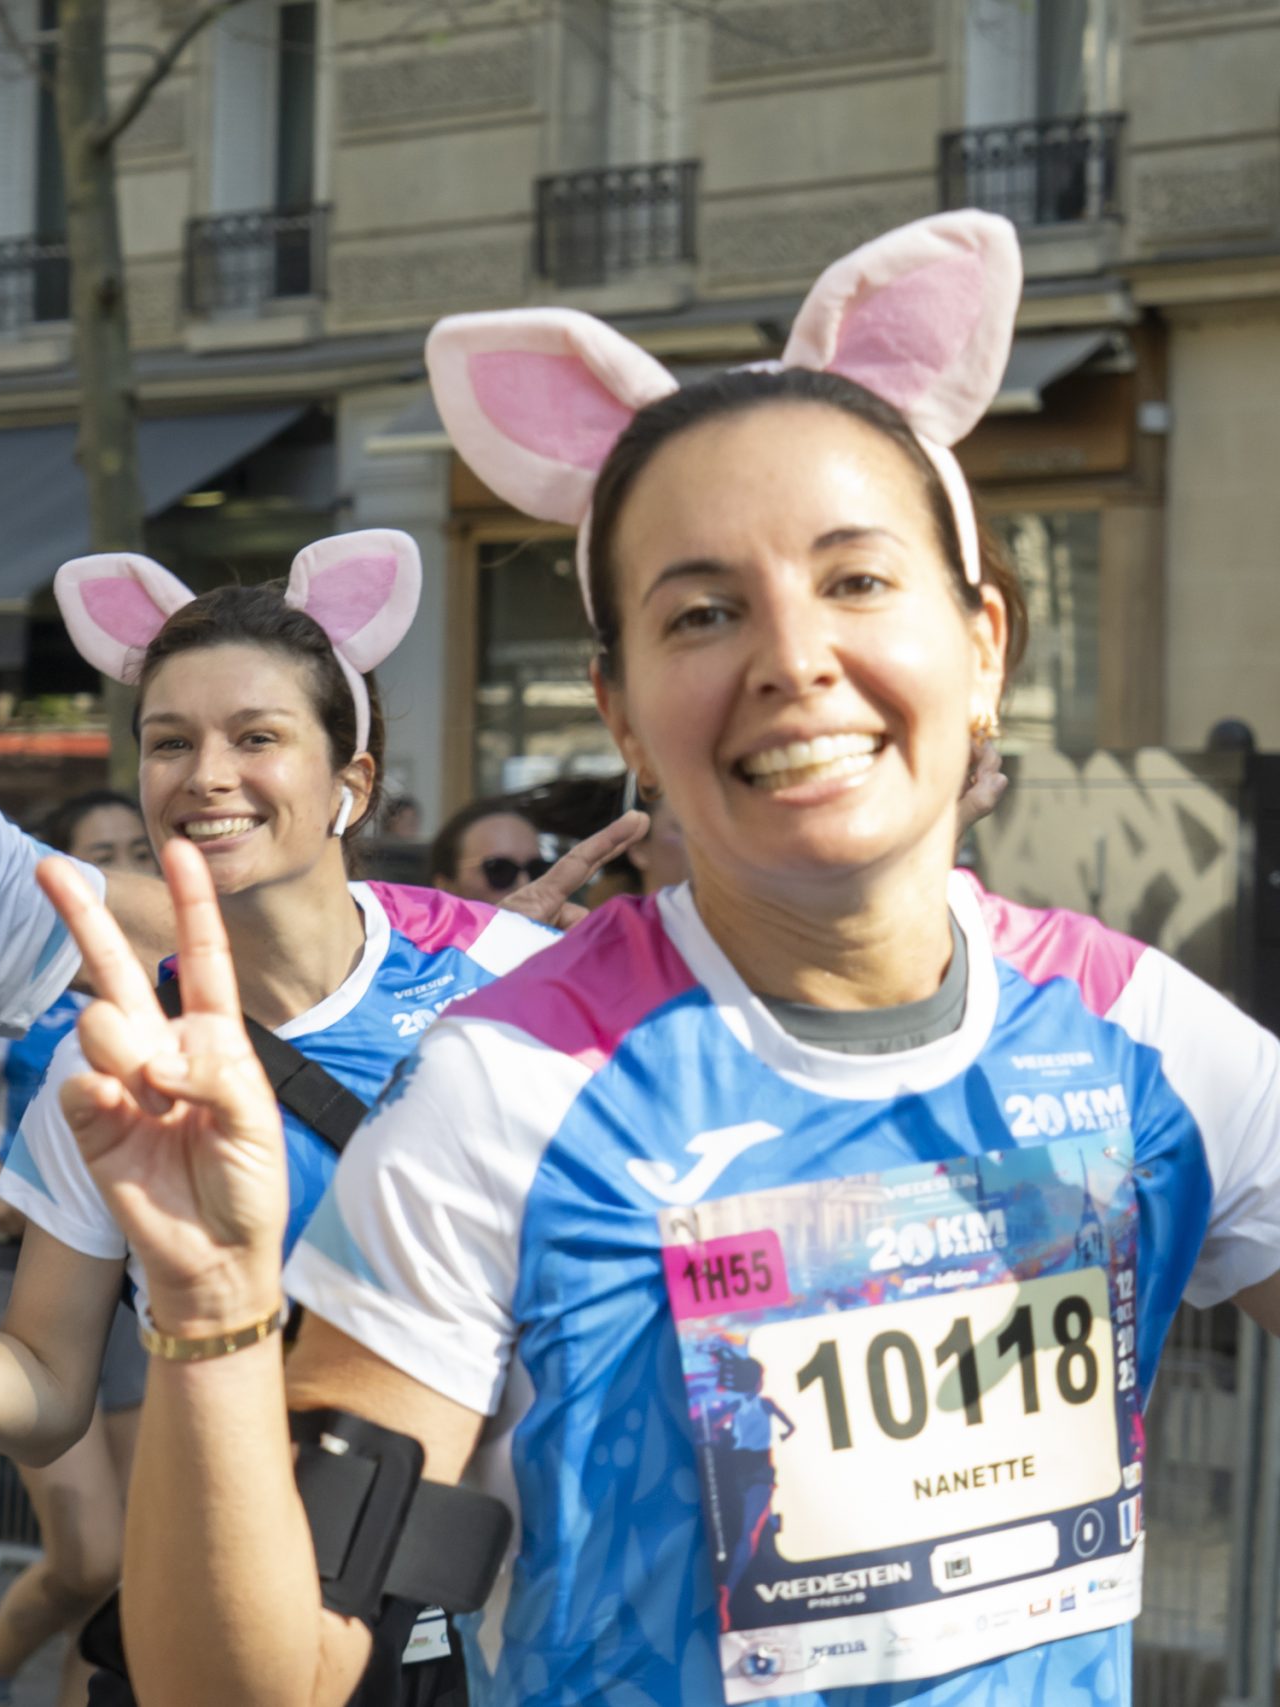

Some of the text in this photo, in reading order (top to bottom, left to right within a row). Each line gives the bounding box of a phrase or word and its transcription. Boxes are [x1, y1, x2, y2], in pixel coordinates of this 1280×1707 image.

[1004, 1083, 1127, 1137] 20 KM
[866, 1208, 1006, 1272] 20 KM
[682, 1249, 773, 1304] 1H55
[795, 1295, 1099, 1453] 10118
[913, 1455, 1036, 1500] NANETTE
[755, 1561, 912, 1603] VREDESTEIN
[807, 1592, 867, 1609] PNEUS
